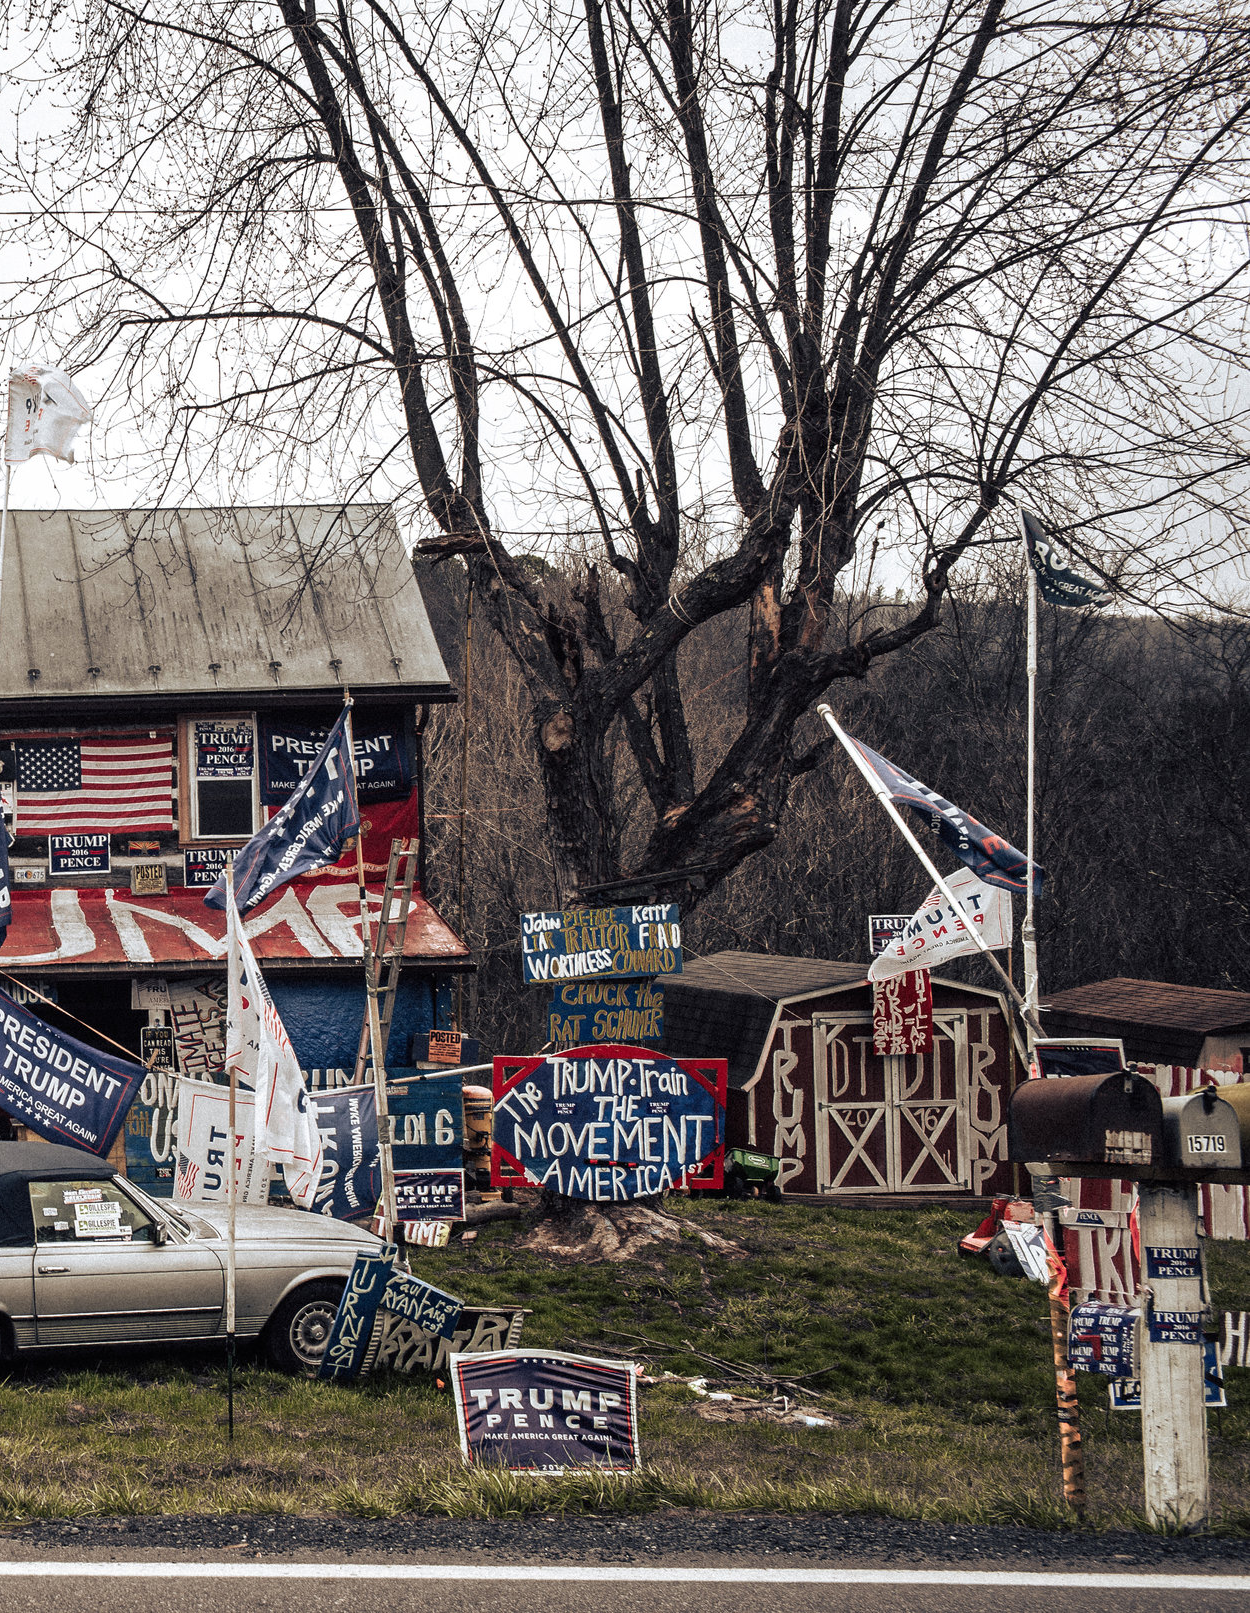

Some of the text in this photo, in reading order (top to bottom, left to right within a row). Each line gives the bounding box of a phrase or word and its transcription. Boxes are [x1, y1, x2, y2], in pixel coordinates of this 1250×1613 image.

[199, 732, 252, 745] TRUMP
[206, 754, 247, 764] PENCE
[271, 780, 296, 789] MAKE
[368, 779, 396, 788] AGAIN!
[52, 834, 107, 848] TRUMP
[60, 857, 101, 868] PENCE
[136, 865, 163, 879] POSTED
[524, 913, 561, 934] John
[632, 904, 671, 924] Kerry
[524, 929, 555, 953] LIAR
[560, 924, 630, 954] TRAITOR
[528, 948, 676, 980] WORTHLESS COWARD
[561, 984, 664, 1008] CHUCK the
[156, 1030, 168, 1038] YOU
[550, 1012, 586, 1042] RAT
[430, 1031, 461, 1044] POSTED
[3, 1043, 85, 1110] TRUMP
[493, 1081, 543, 1123] The
[593, 1095, 641, 1122] THE
[772, 1019, 811, 1194] TRUMP
[967, 1007, 1008, 1196] TRUMP
[34, 1100, 66, 1127] GREAT
[65, 1119, 97, 1144] AGAIN!
[842, 1109, 870, 1126] 20
[514, 1115, 713, 1164] MOVEMENT
[1188, 1136, 1226, 1152] 15719
[541, 1158, 674, 1200] AMERICA
[1151, 1248, 1198, 1259] TRUMP
[1158, 1267, 1195, 1276] PENCE
[1153, 1312, 1200, 1323] TRUMP
[1161, 1331, 1197, 1340] PENCE
[470, 1389, 621, 1412] TRUMP
[486, 1414, 608, 1429] PENCE
